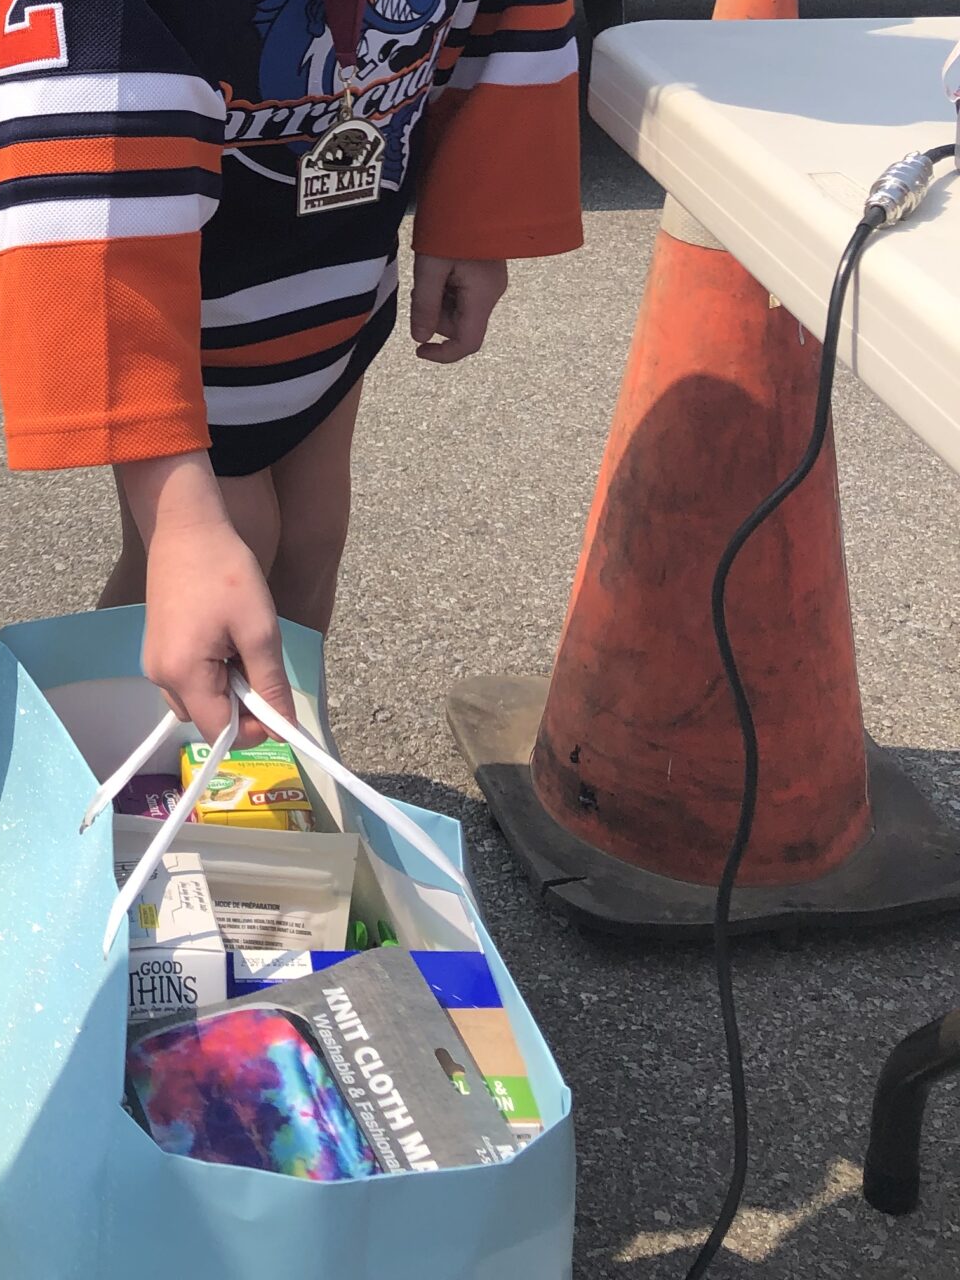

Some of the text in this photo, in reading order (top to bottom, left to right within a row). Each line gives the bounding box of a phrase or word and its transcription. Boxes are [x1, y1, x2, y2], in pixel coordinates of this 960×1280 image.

[303, 165, 376, 198] ICE KATS
[252, 789, 305, 804] GLAD
[140, 960, 183, 975] GOOD
[129, 971, 198, 1007] THINS
[313, 1013, 355, 1085] Washable
[348, 1086, 366, 1099] &
[322, 986, 370, 1041] KNIT
[354, 1046, 414, 1131] CLOTH
